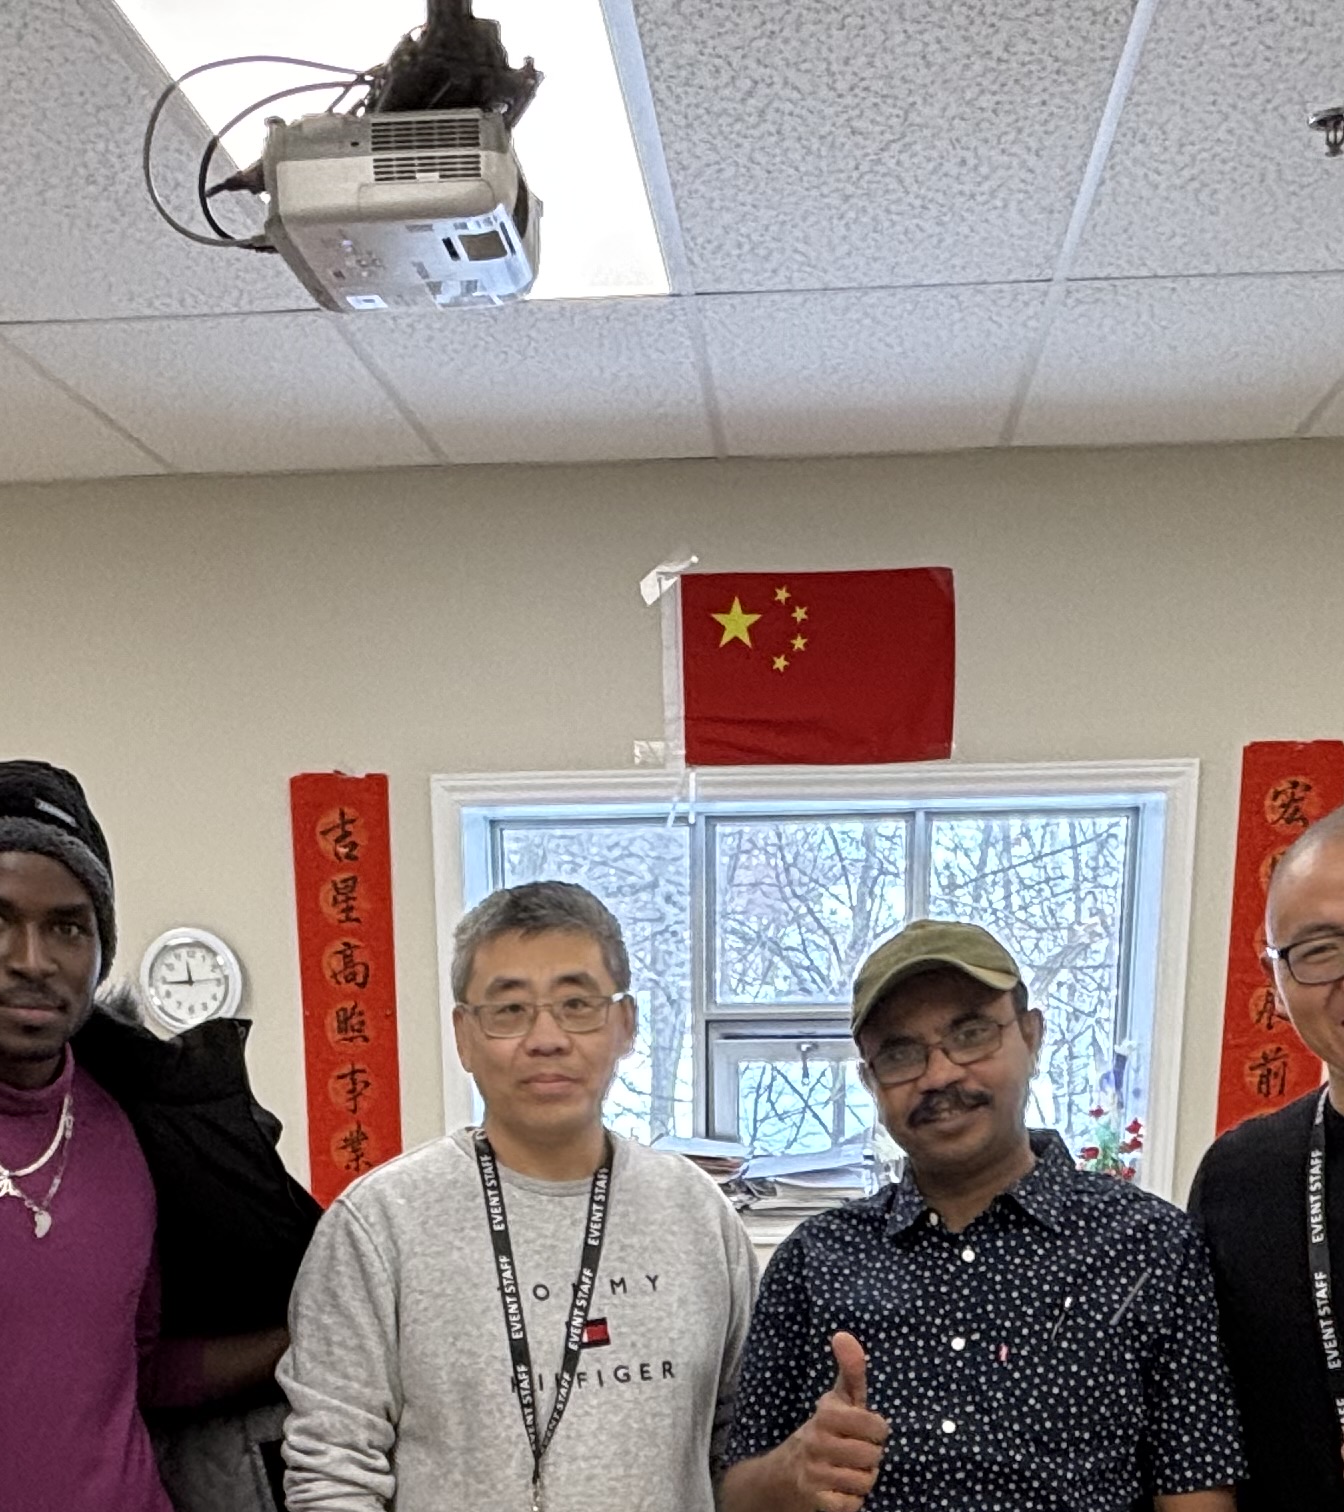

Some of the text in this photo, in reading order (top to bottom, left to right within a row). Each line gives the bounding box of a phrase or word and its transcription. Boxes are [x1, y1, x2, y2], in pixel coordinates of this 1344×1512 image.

[479, 1154, 505, 1232] EVENT STAFF
[588, 1203, 605, 1246] EVENT
[1309, 1149, 1325, 1244] EVENT STAFF
[499, 1255, 524, 1339] EVENT STAFF
[568, 1268, 594, 1351] EVENT STAFF
[1314, 1271, 1342, 1370] EVENT STAFF
[516, 1363, 533, 1404] STAFF
